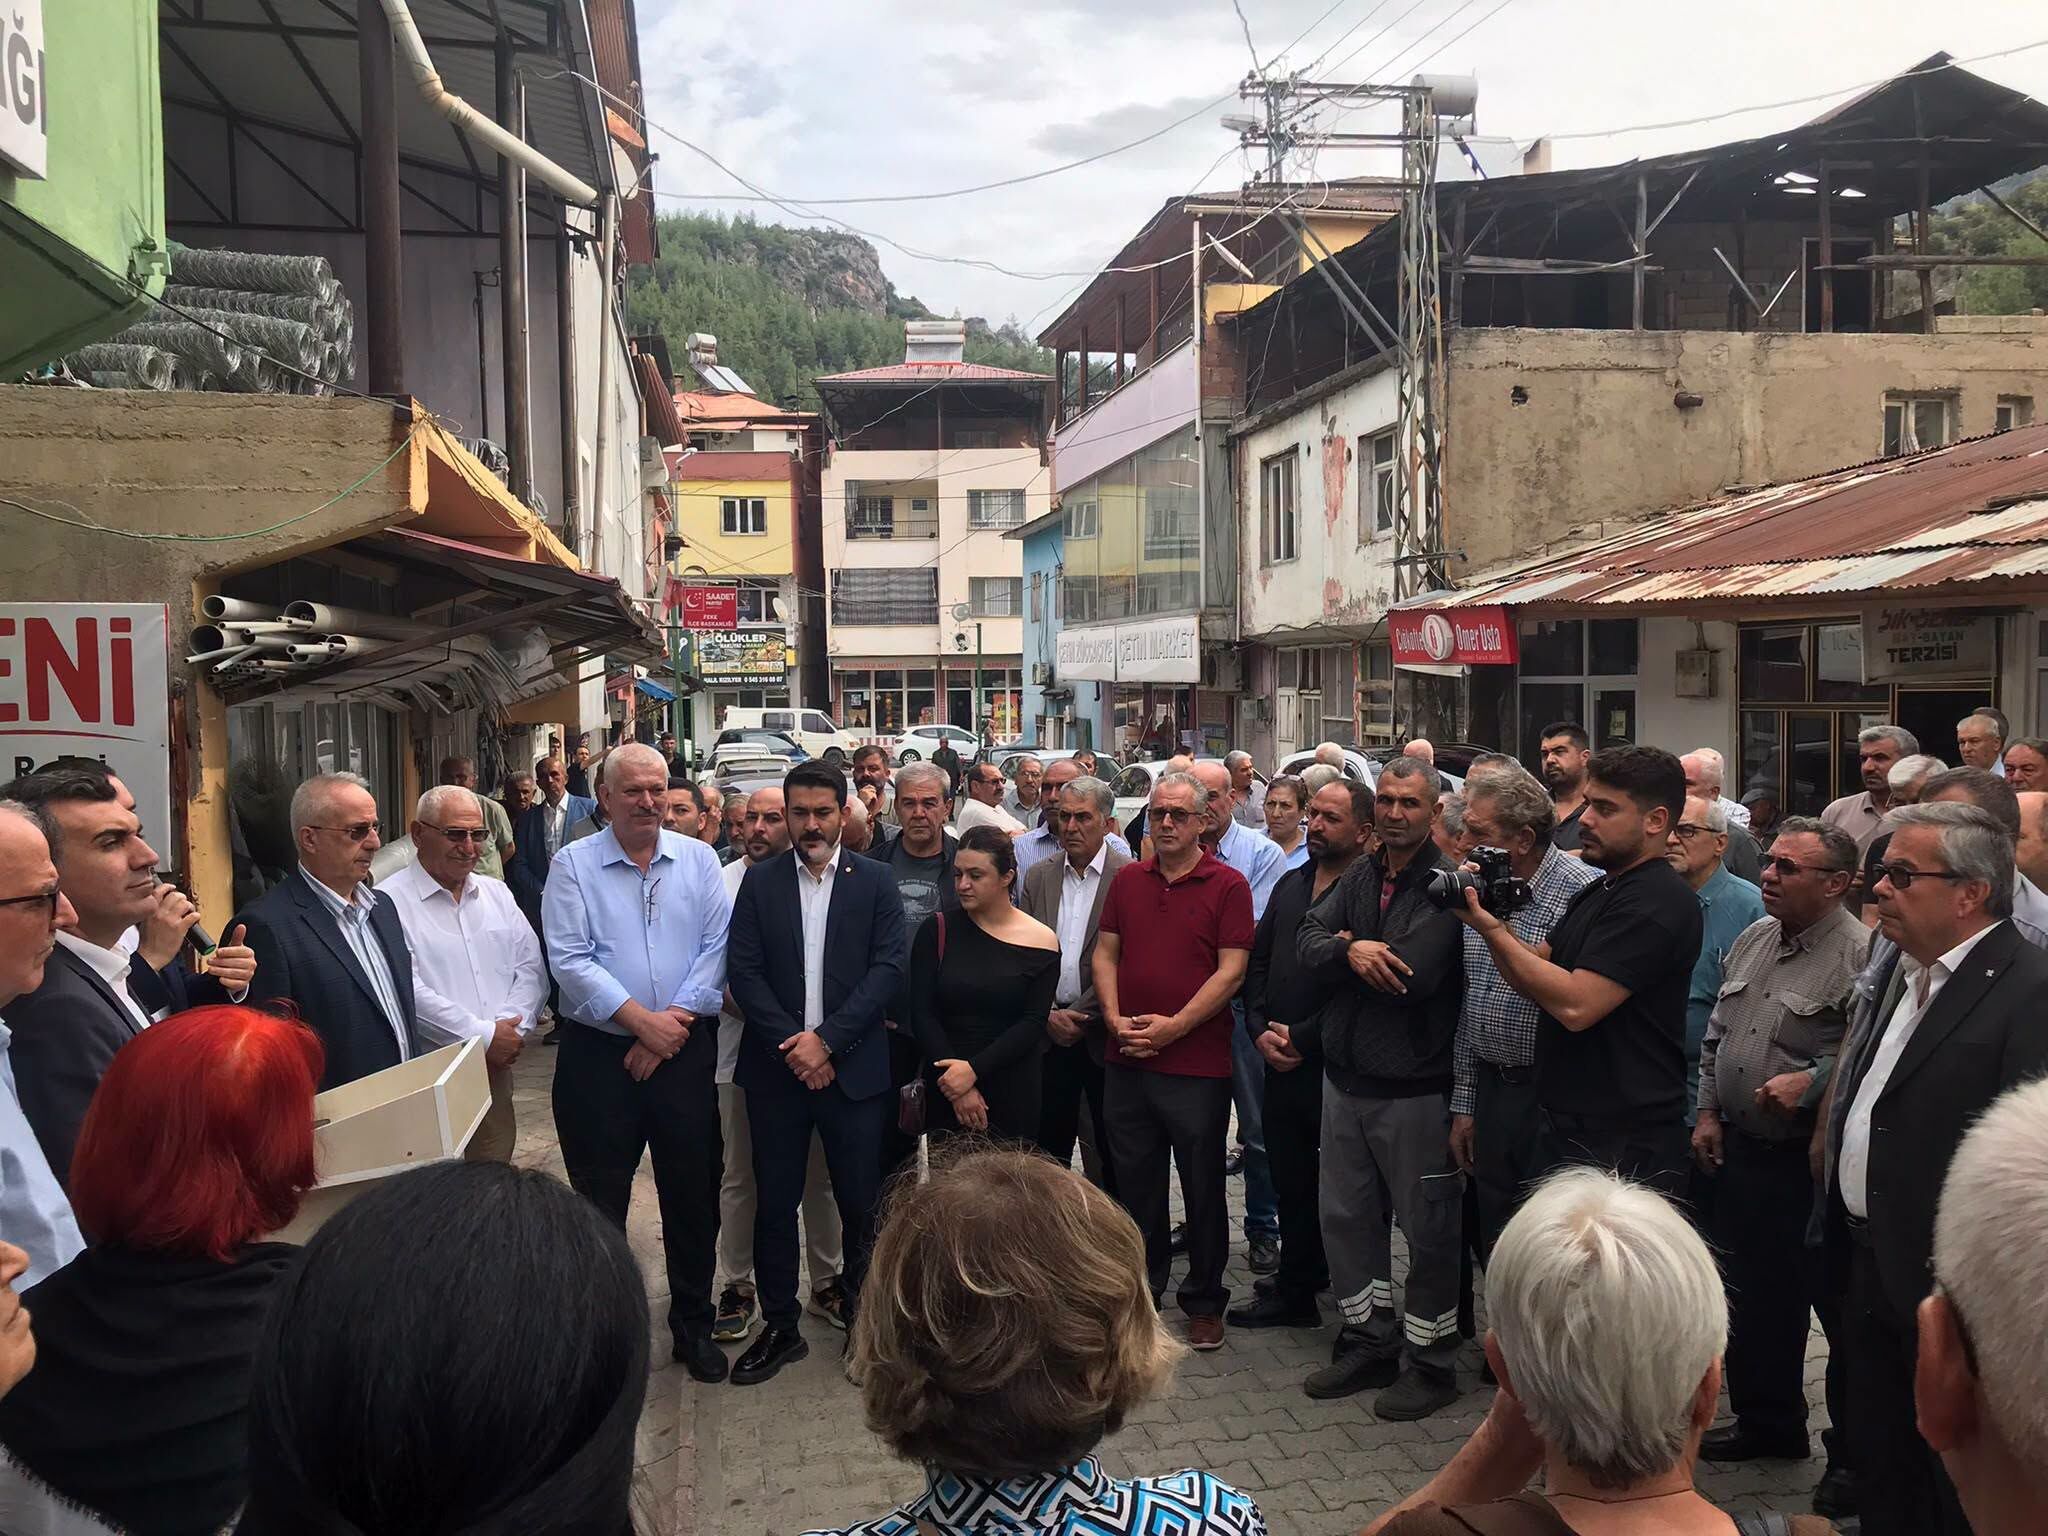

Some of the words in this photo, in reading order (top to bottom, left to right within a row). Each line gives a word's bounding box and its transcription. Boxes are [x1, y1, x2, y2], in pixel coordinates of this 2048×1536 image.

[705, 592, 736, 601] SAADET
[687, 619, 700, 627] İLÇE
[700, 619, 734, 627] BAŞKANLIĞI
[1120, 631, 1147, 669] ÇETİN
[1149, 627, 1195, 659] MARKET
[1479, 623, 1502, 651] Usta
[1886, 641, 1958, 664] TERZİSİ
